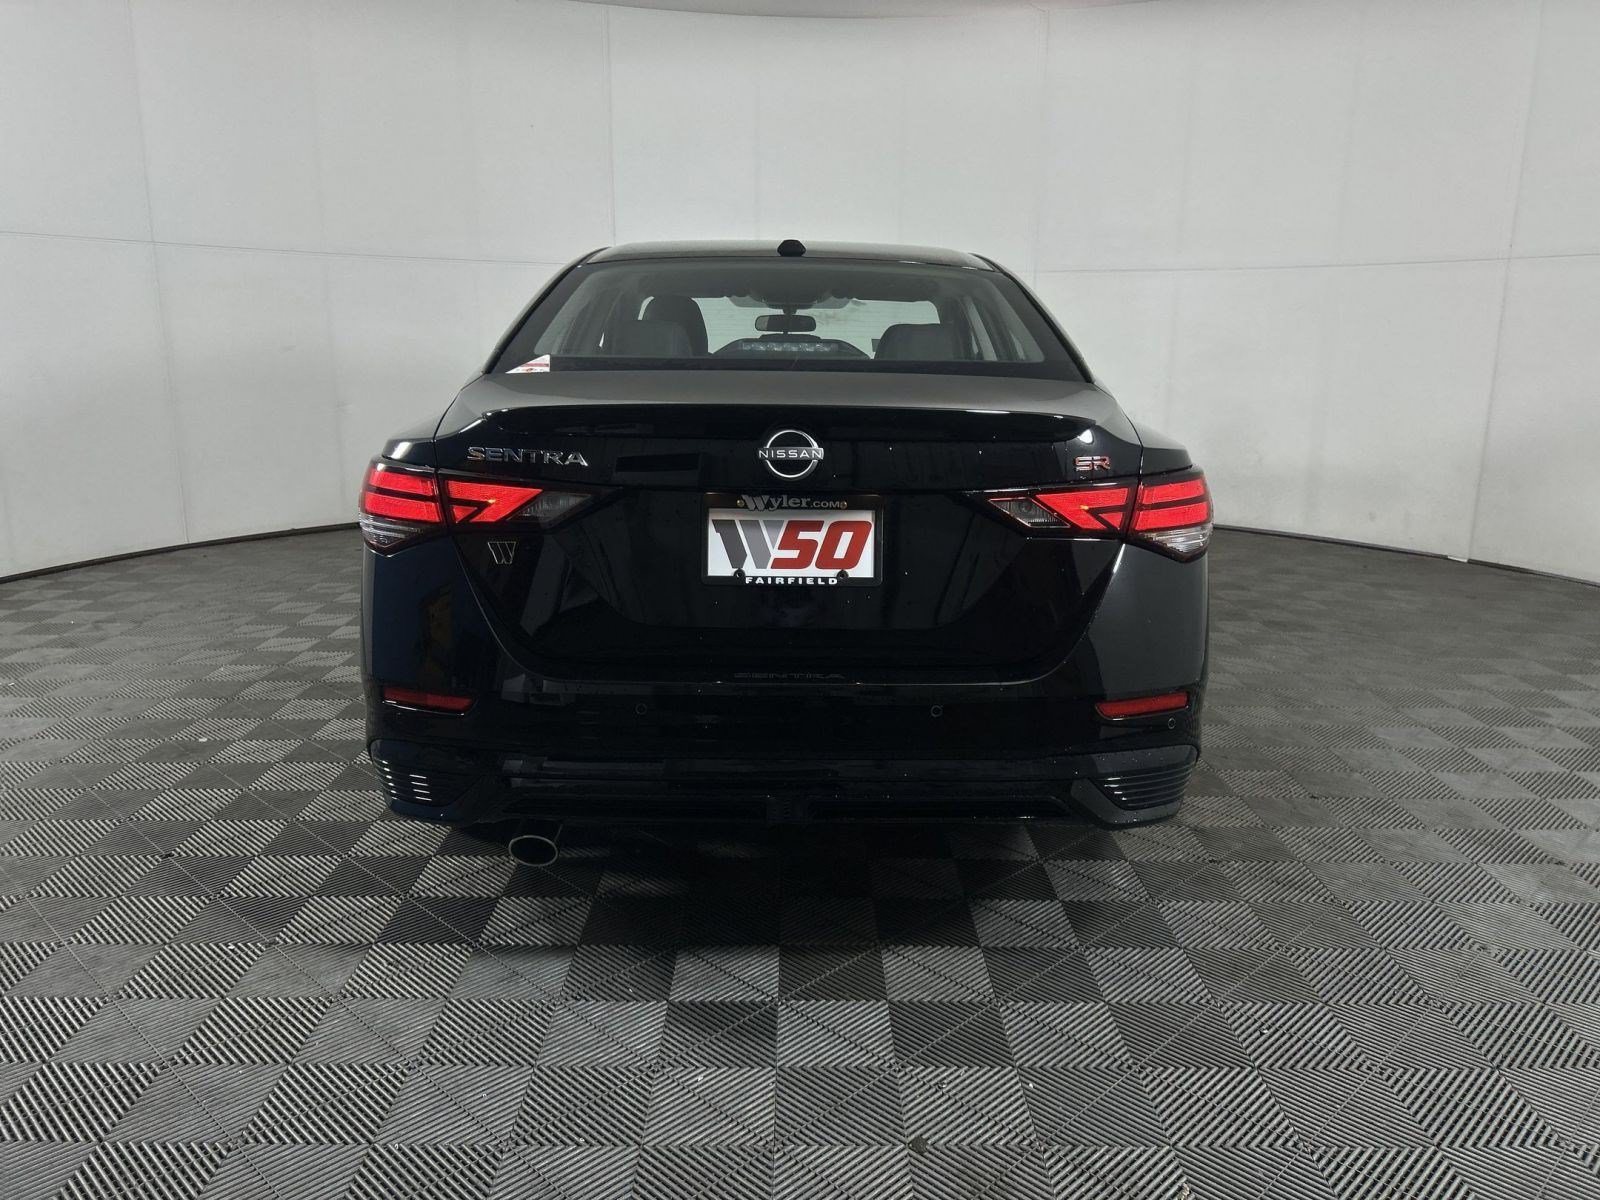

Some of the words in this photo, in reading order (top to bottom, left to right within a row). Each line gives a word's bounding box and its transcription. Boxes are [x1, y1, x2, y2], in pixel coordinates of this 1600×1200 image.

[467, 446, 589, 467] SENTRA
[758, 449, 822, 459] NISSAN
[1075, 455, 1111, 471] SR
[745, 576, 838, 585] FAIRFIELD
